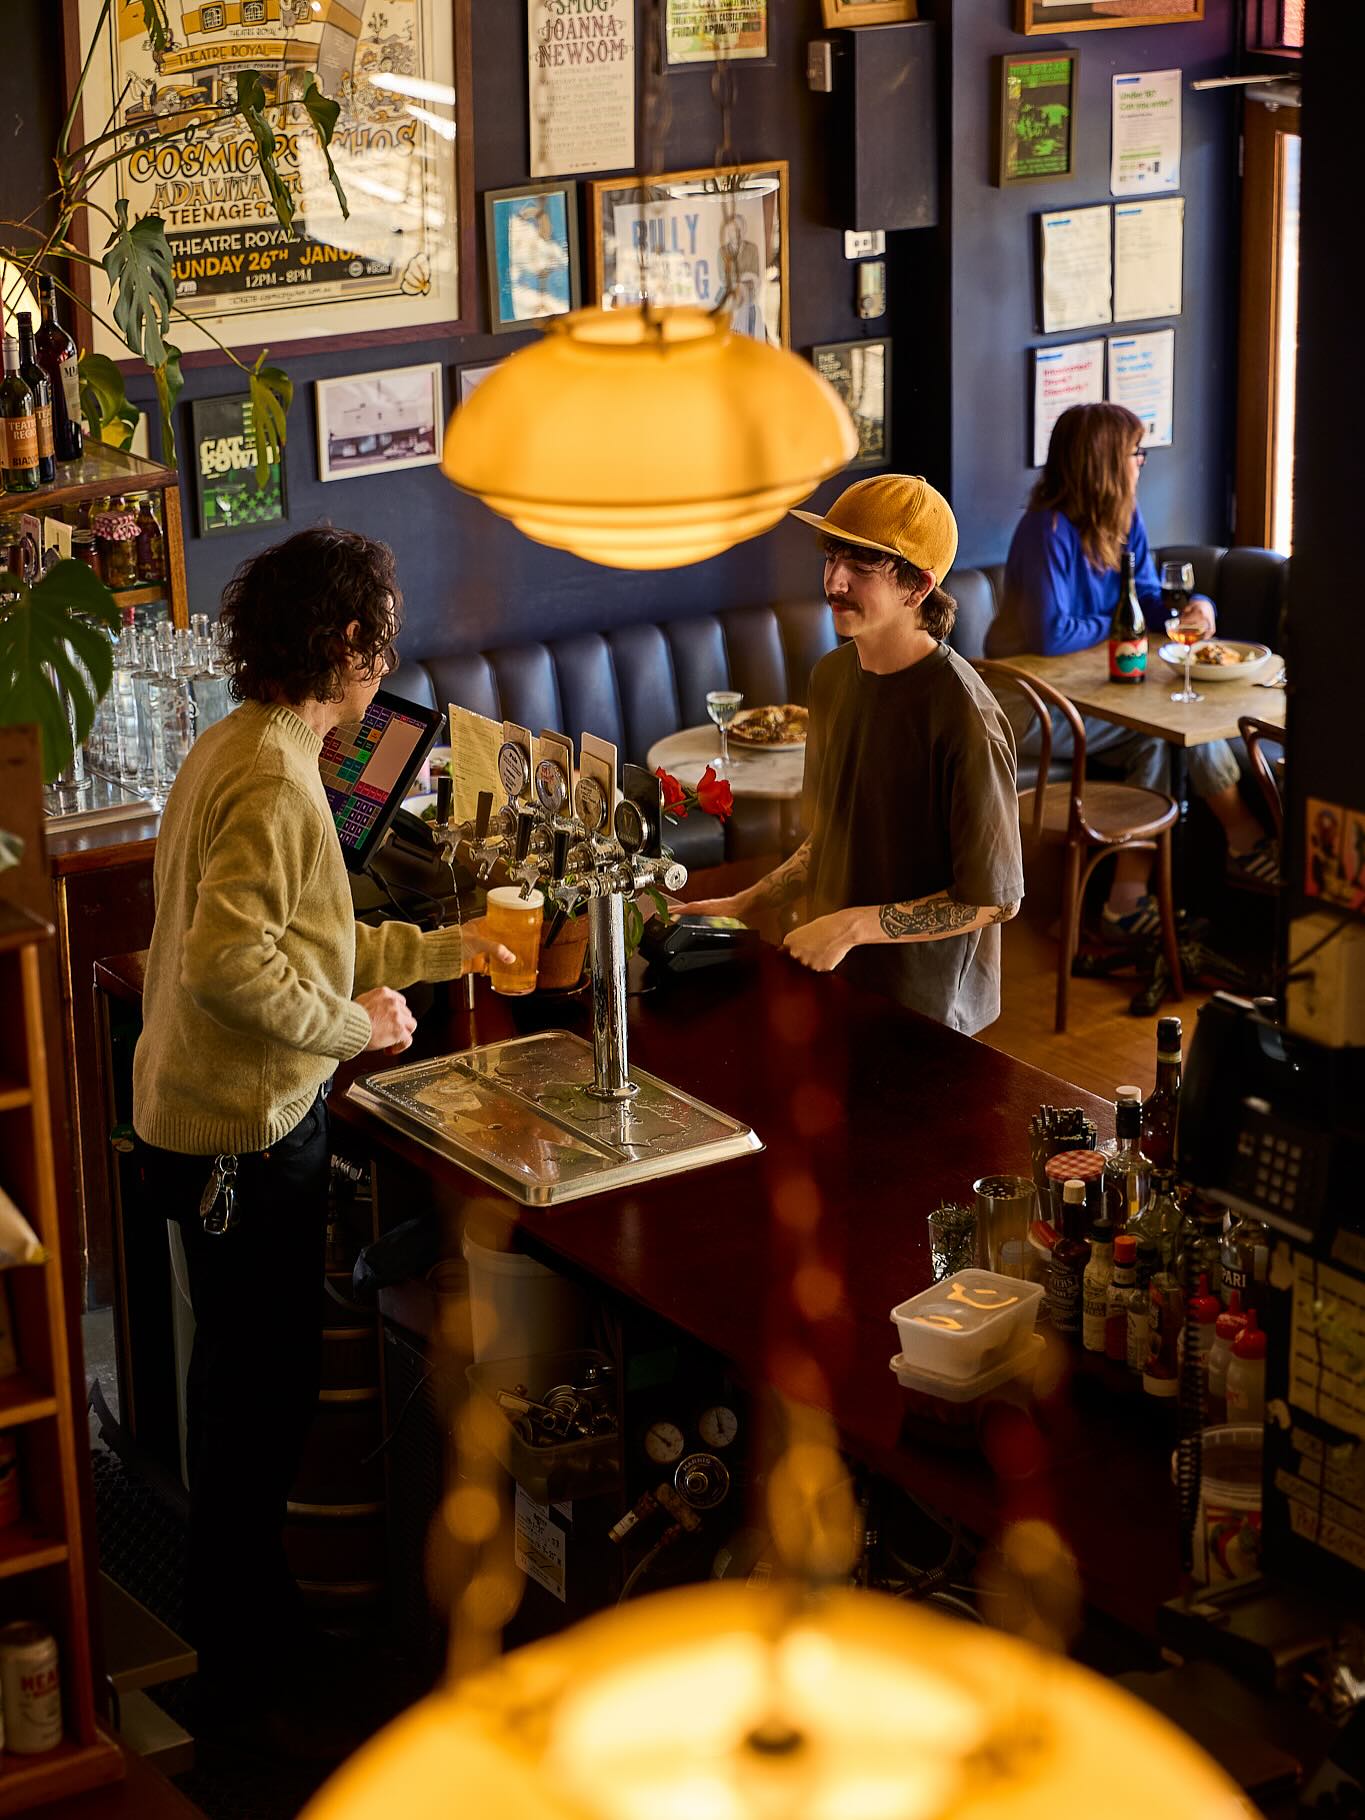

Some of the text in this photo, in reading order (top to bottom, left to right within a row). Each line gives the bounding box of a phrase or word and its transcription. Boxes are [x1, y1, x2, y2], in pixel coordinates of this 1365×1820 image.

[543, 15, 617, 42] JOANNA
[177, 43, 269, 66] THEATRE ROYAL
[537, 39, 624, 68] NEWSOM
[271, 119, 418, 169] PSCHOS
[129, 138, 260, 184] COSMIC
[151, 174, 266, 210] ADALITA
[169, 203, 252, 226] TEENAGE
[169, 233, 241, 257] THEATRE
[248, 248, 289, 271] 26TH
[246, 271, 277, 288] 12PM
[285, 268, 312, 284] 8PM
[200, 436, 244, 463] CAT
[201, 446, 280, 475] POW
